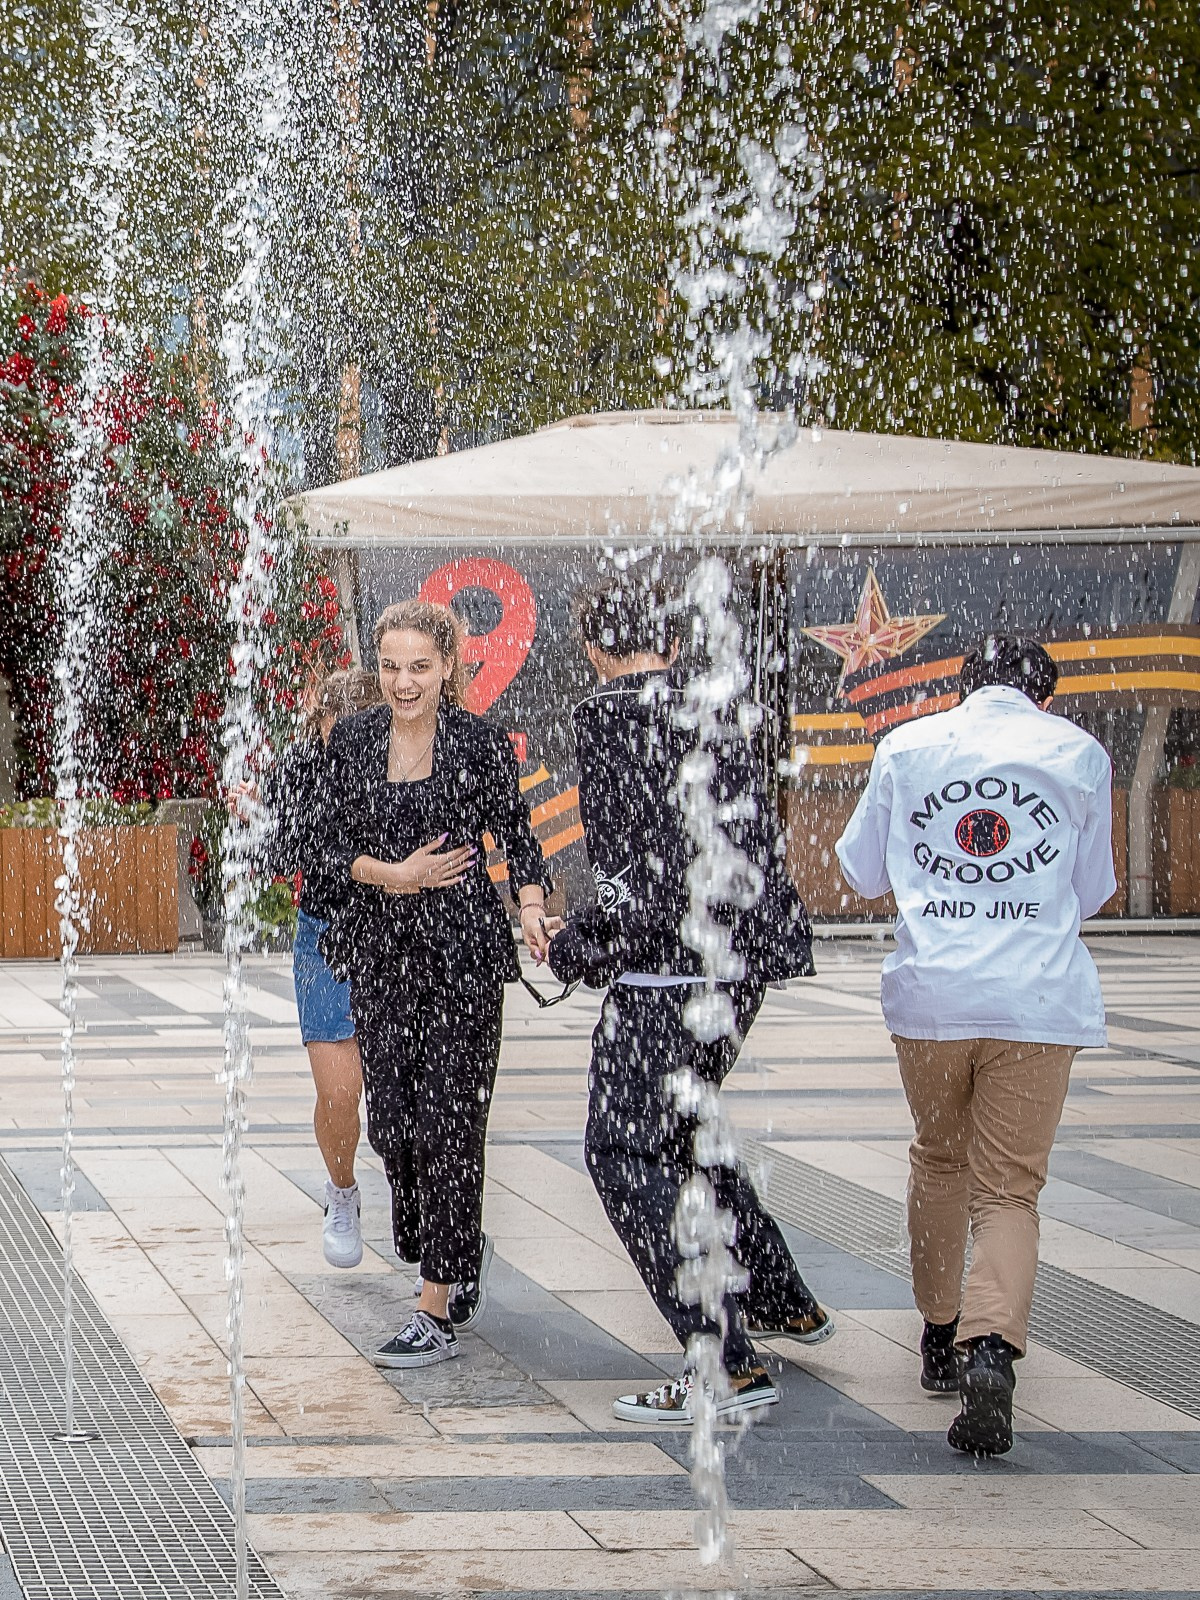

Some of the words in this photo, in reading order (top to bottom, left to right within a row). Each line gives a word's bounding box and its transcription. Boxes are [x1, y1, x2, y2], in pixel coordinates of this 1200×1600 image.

[417, 557, 537, 717] 9
[909, 777, 1059, 830] MOOVE
[913, 838, 1060, 884] GROOVE
[921, 899, 976, 919] AND
[985, 901, 1040, 920] JIVE
